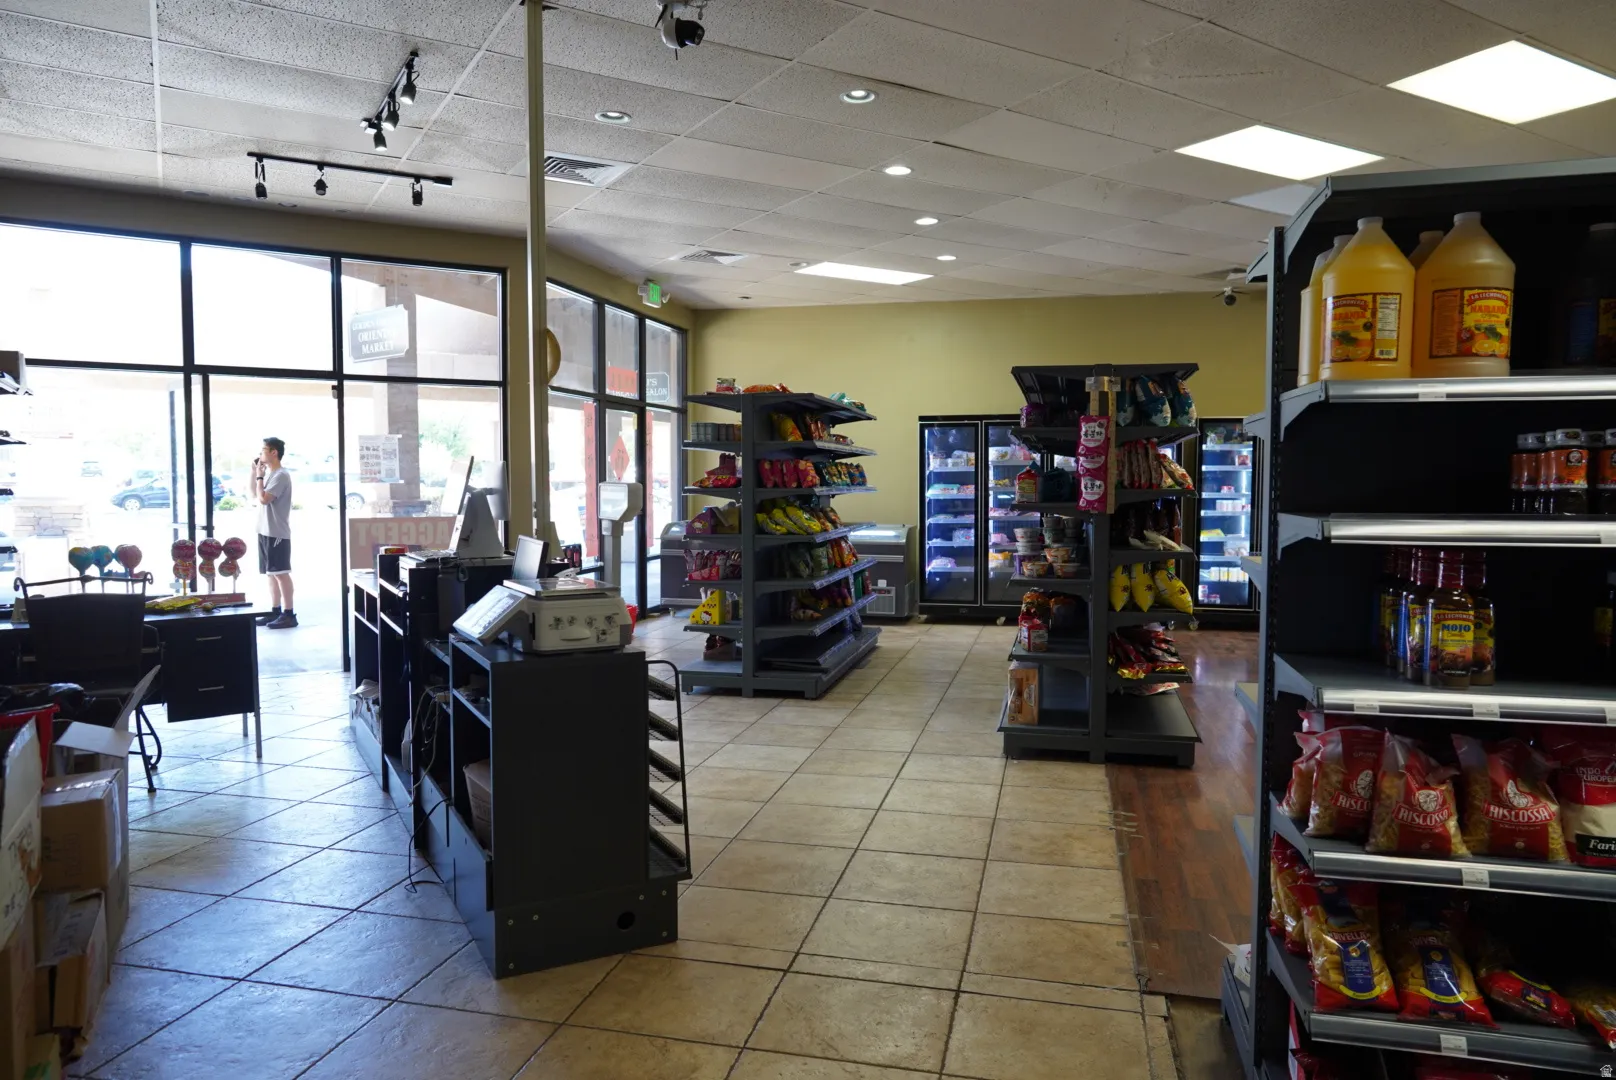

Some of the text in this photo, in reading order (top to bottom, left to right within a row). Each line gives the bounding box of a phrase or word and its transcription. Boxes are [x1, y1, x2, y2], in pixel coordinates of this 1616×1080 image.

[358, 327, 396, 343] ORIENT
[361, 340, 394, 355] MARKET
[1442, 623, 1471, 633] MOJO
[1400, 808, 1448, 826] RISCOSSA
[1489, 804, 1550, 823] RISCOSSA
[1589, 838, 1616, 851] Fari
